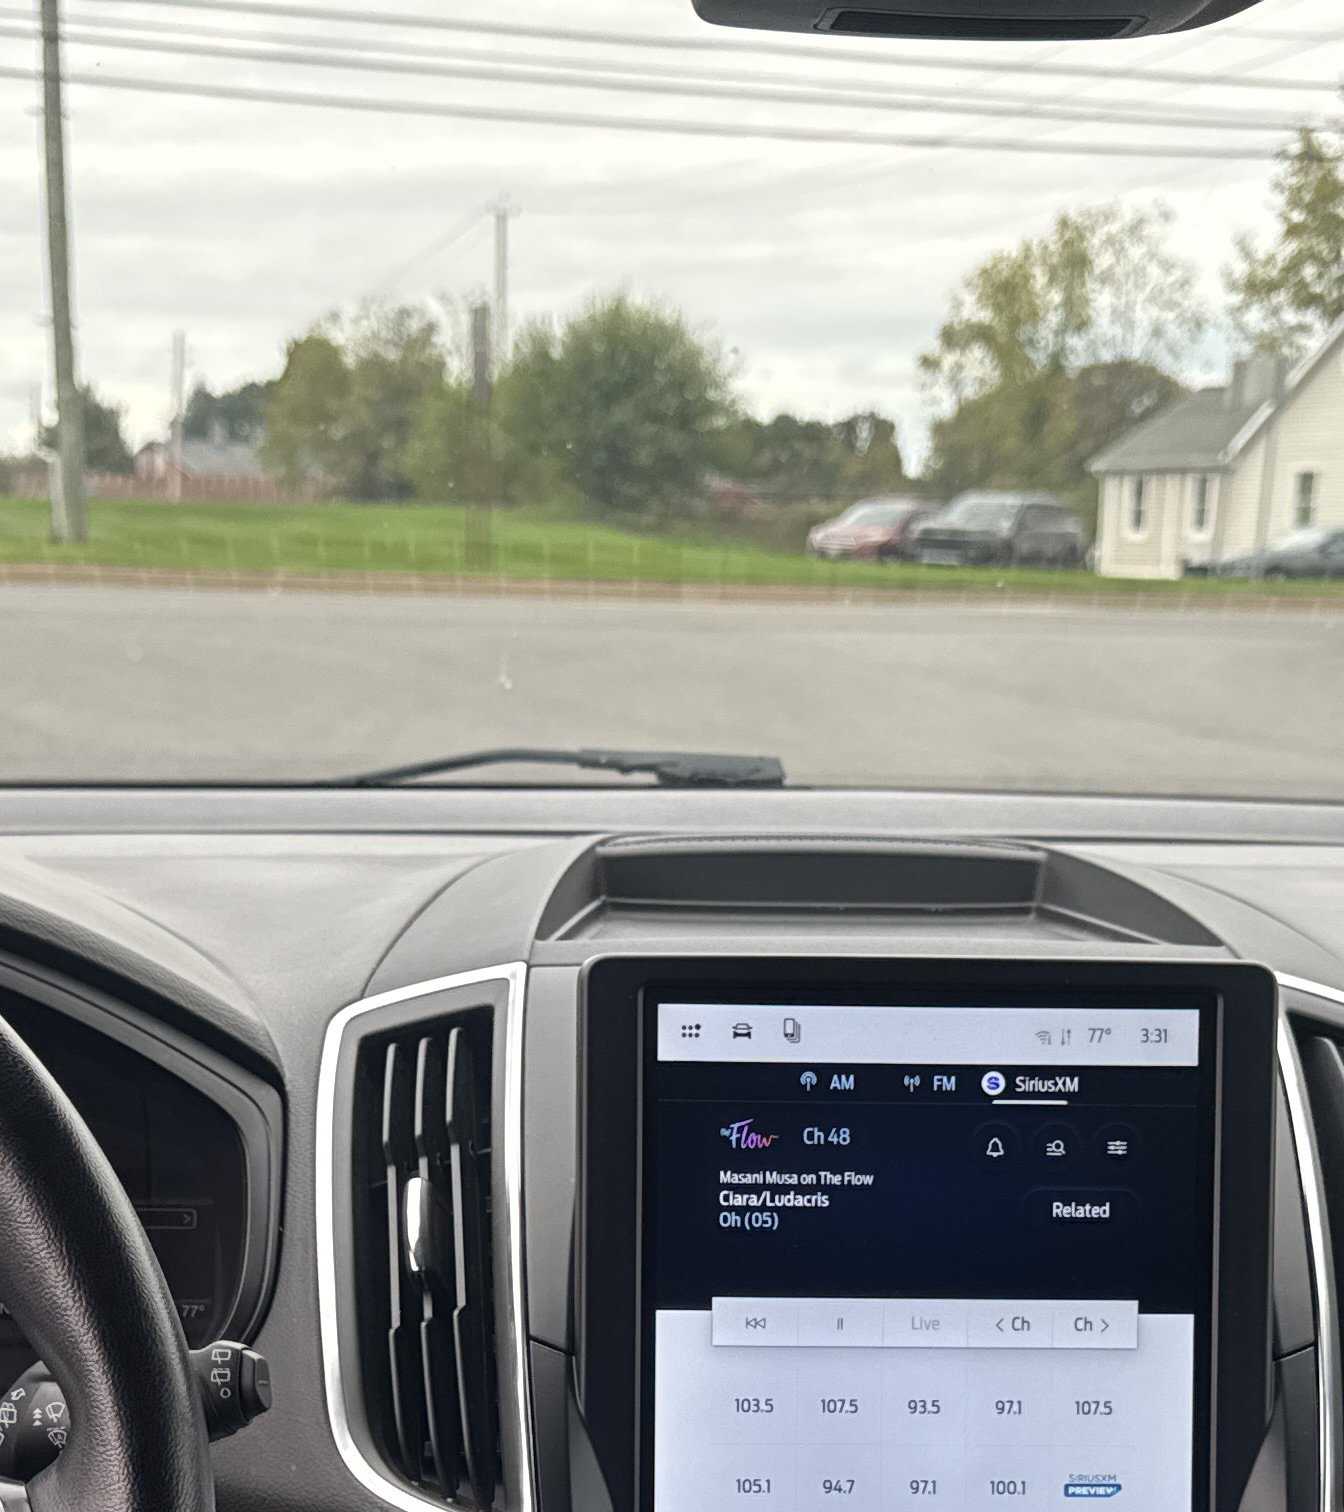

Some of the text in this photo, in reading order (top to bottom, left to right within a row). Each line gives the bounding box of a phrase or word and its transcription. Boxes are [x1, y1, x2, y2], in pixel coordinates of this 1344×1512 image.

[1087, 1027, 1112, 1044] 77°
[1140, 1028, 1169, 1044] 3:31
[830, 1075, 855, 1091] AM
[933, 1076, 956, 1092] FM
[1015, 1075, 1079, 1093] SiriusXM
[729, 1118, 779, 1149] Flow
[803, 1127, 851, 1145] Ch 48
[719, 1170, 874, 1185] Masani Musa on The Flow
[719, 1190, 830, 1207] Ciara/Ludacris
[1052, 1202, 1110, 1219] Related
[719, 1212, 779, 1230] Oh (05)
[911, 1316, 940, 1331] Live
[1011, 1317, 1031, 1332] Ch
[1074, 1317, 1093, 1332] Ch
[734, 1398, 774, 1414] 103.5
[820, 1398, 859, 1414] 107.5
[907, 1399, 941, 1415] 93.5
[995, 1400, 1023, 1416] 97.1
[1074, 1400, 1113, 1416] 107.5
[735, 1478, 772, 1494] 105.1
[822, 1479, 855, 1495] 94.7
[909, 1480, 937, 1496] 97.1
[989, 1480, 1027, 1496] 100.1
[1068, 1486, 1116, 1495] PREVIEW
